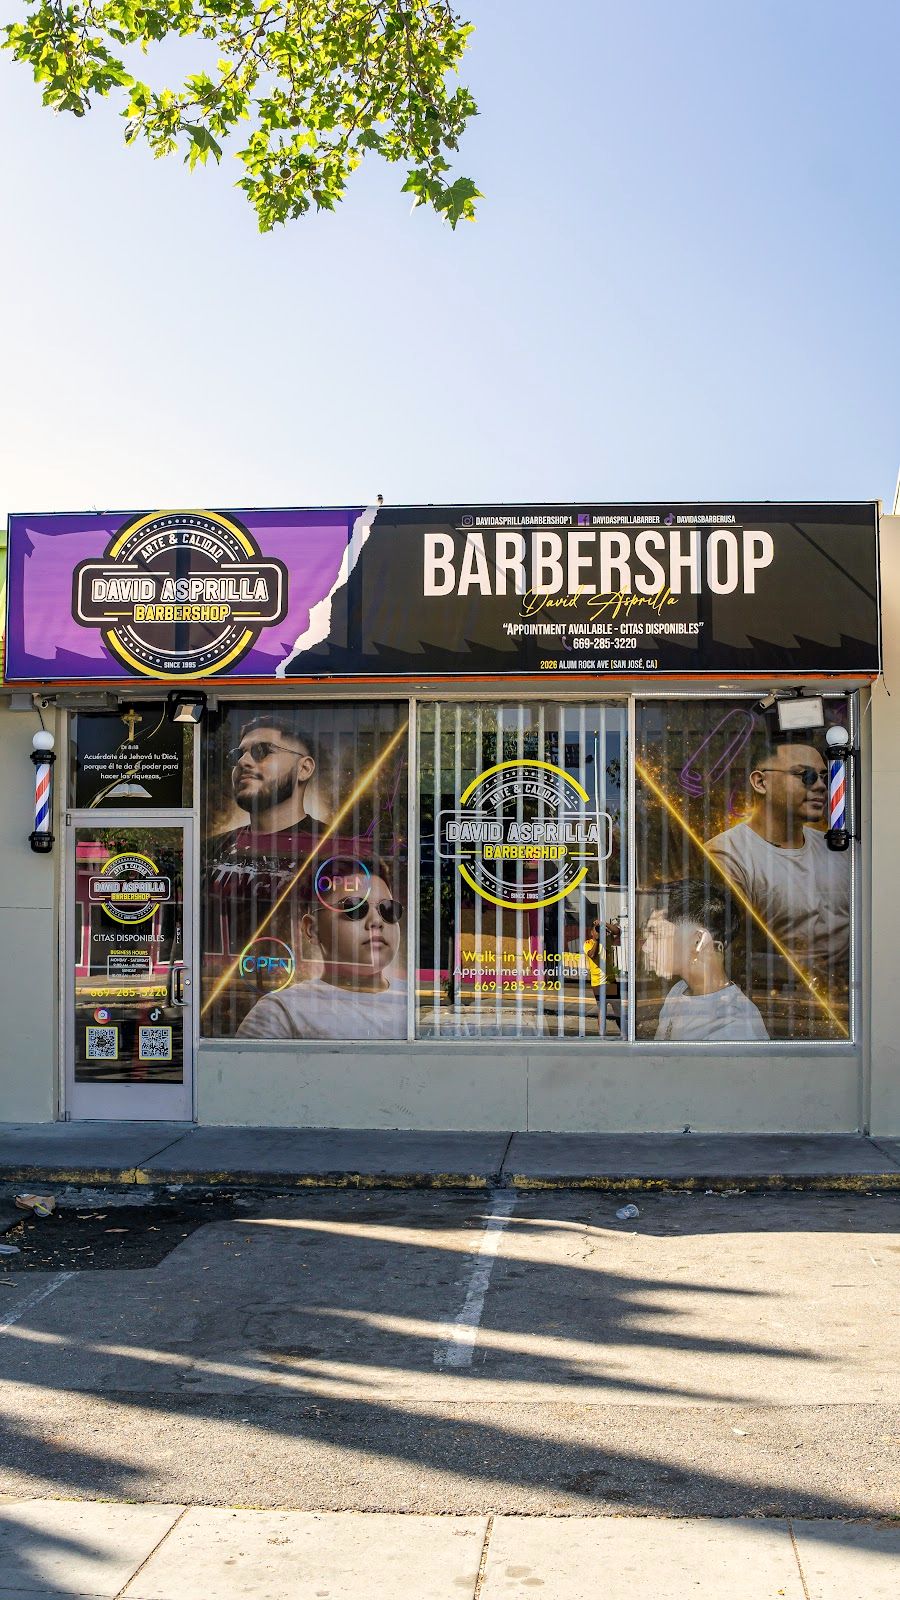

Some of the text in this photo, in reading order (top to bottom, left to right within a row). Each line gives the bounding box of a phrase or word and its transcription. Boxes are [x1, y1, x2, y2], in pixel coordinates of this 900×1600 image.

[475, 515, 573, 526] DAVIDASPRILLABARBERSHOP1
[592, 515, 661, 525] DAVIDASPRILLABARBER
[141, 532, 224, 559] ARTE & CALIDAD
[423, 529, 775, 597] BARBERSHOP
[91, 577, 270, 602] DAVID ASPRILLA
[519, 584, 679, 621] David Asprilla
[133, 603, 231, 623] BARBERSHOP
[568, 623, 613, 636] AVAILABLE
[620, 623, 644, 635] CITAS
[573, 637, 637, 649] 669-285-3220
[163, 661, 181, 669] SINCE
[540, 660, 558, 670] 2026
[559, 660, 578, 669] ALUM
[578, 660, 596, 669] ROCK
[597, 660, 610, 669] AVE
[83, 752, 118, 760] Acuérdate
[128, 752, 153, 760] Jehová
[141, 763, 161, 771] poder
[489, 784, 561, 807] ARTE & CALIDAD
[446, 822, 600, 844] DAVID ASPRILLA
[483, 844, 568, 861] BARBERSHOP
[93, 881, 166, 893] DAVID ASPRILLA
[111, 892, 151, 902] BARBERSHOP
[93, 934, 165, 942] CITAS DISPONIBLES
[242, 956, 292, 974] OPEN
[532, 966, 589, 977] available
[473, 980, 562, 992] 669-285-3220
